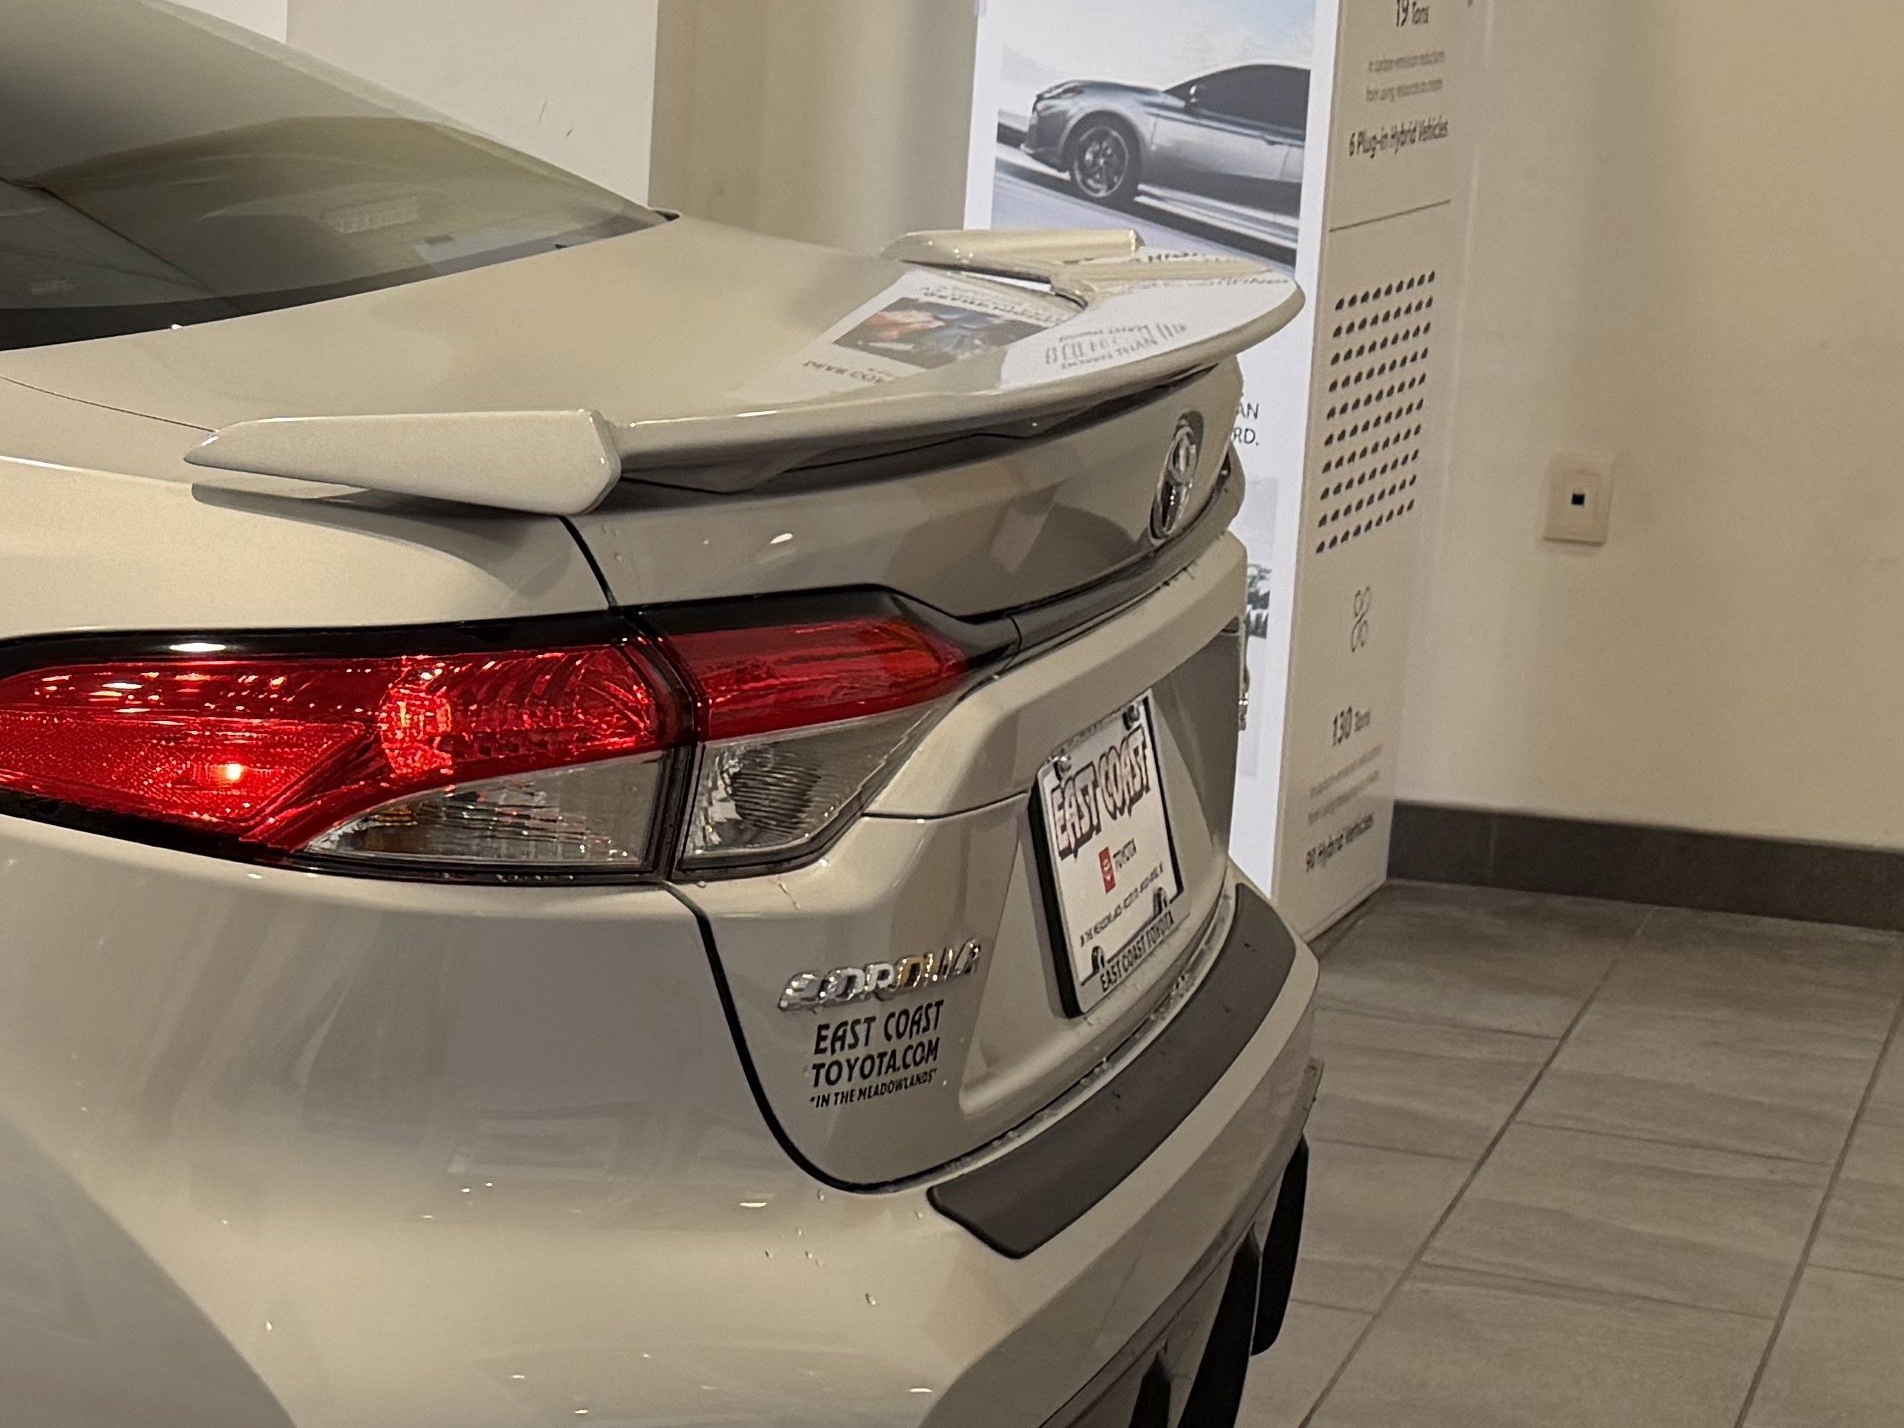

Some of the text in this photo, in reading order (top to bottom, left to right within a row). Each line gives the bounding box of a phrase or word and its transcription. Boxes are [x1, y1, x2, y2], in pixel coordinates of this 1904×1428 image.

[1411, 0, 1431, 26] Tons
[1349, 132, 1356, 157] 6
[1357, 126, 1388, 160] Plug-in
[1332, 705, 1353, 747] 130
[1050, 724, 1151, 862] EAST COAST
[1099, 959, 1122, 993] EAST
[1121, 933, 1147, 974] COAST
[813, 999, 945, 1056] EAST COAST
[810, 1036, 941, 1089] TOYOTA.COM
[833, 1088, 856, 1106] THE
